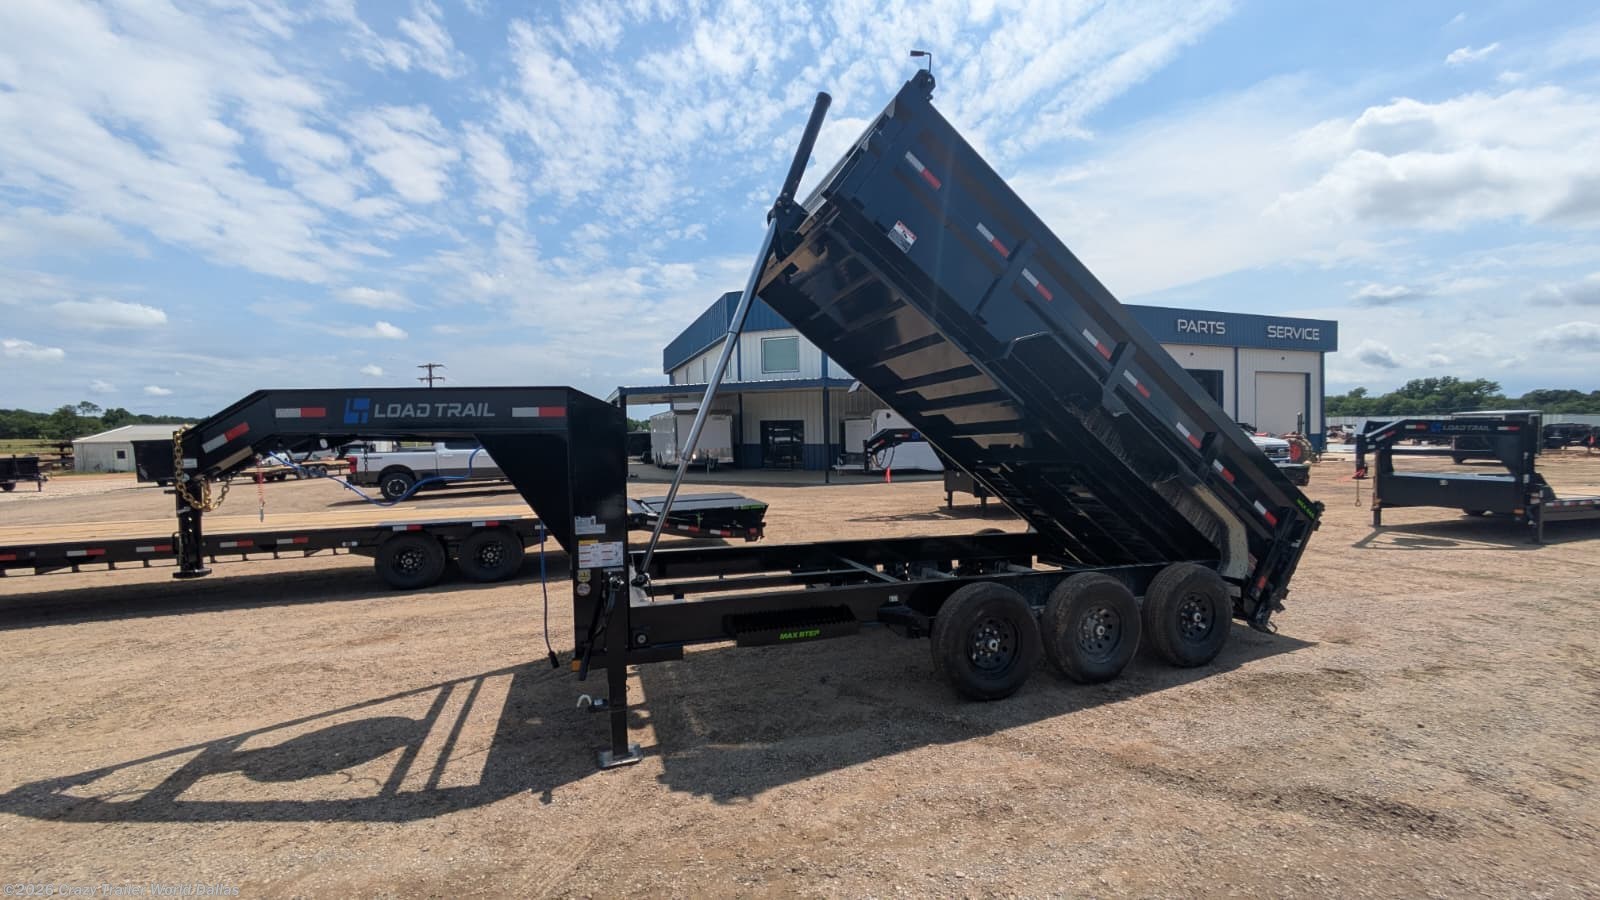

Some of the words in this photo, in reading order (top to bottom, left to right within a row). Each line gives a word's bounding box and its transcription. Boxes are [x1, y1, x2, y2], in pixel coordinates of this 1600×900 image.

[1177, 319, 1226, 335] PARTS
[1267, 325, 1320, 341] SERVICE
[374, 403, 430, 418] LOAD
[434, 402, 496, 417] TRAIL
[779, 631, 798, 640] MAX
